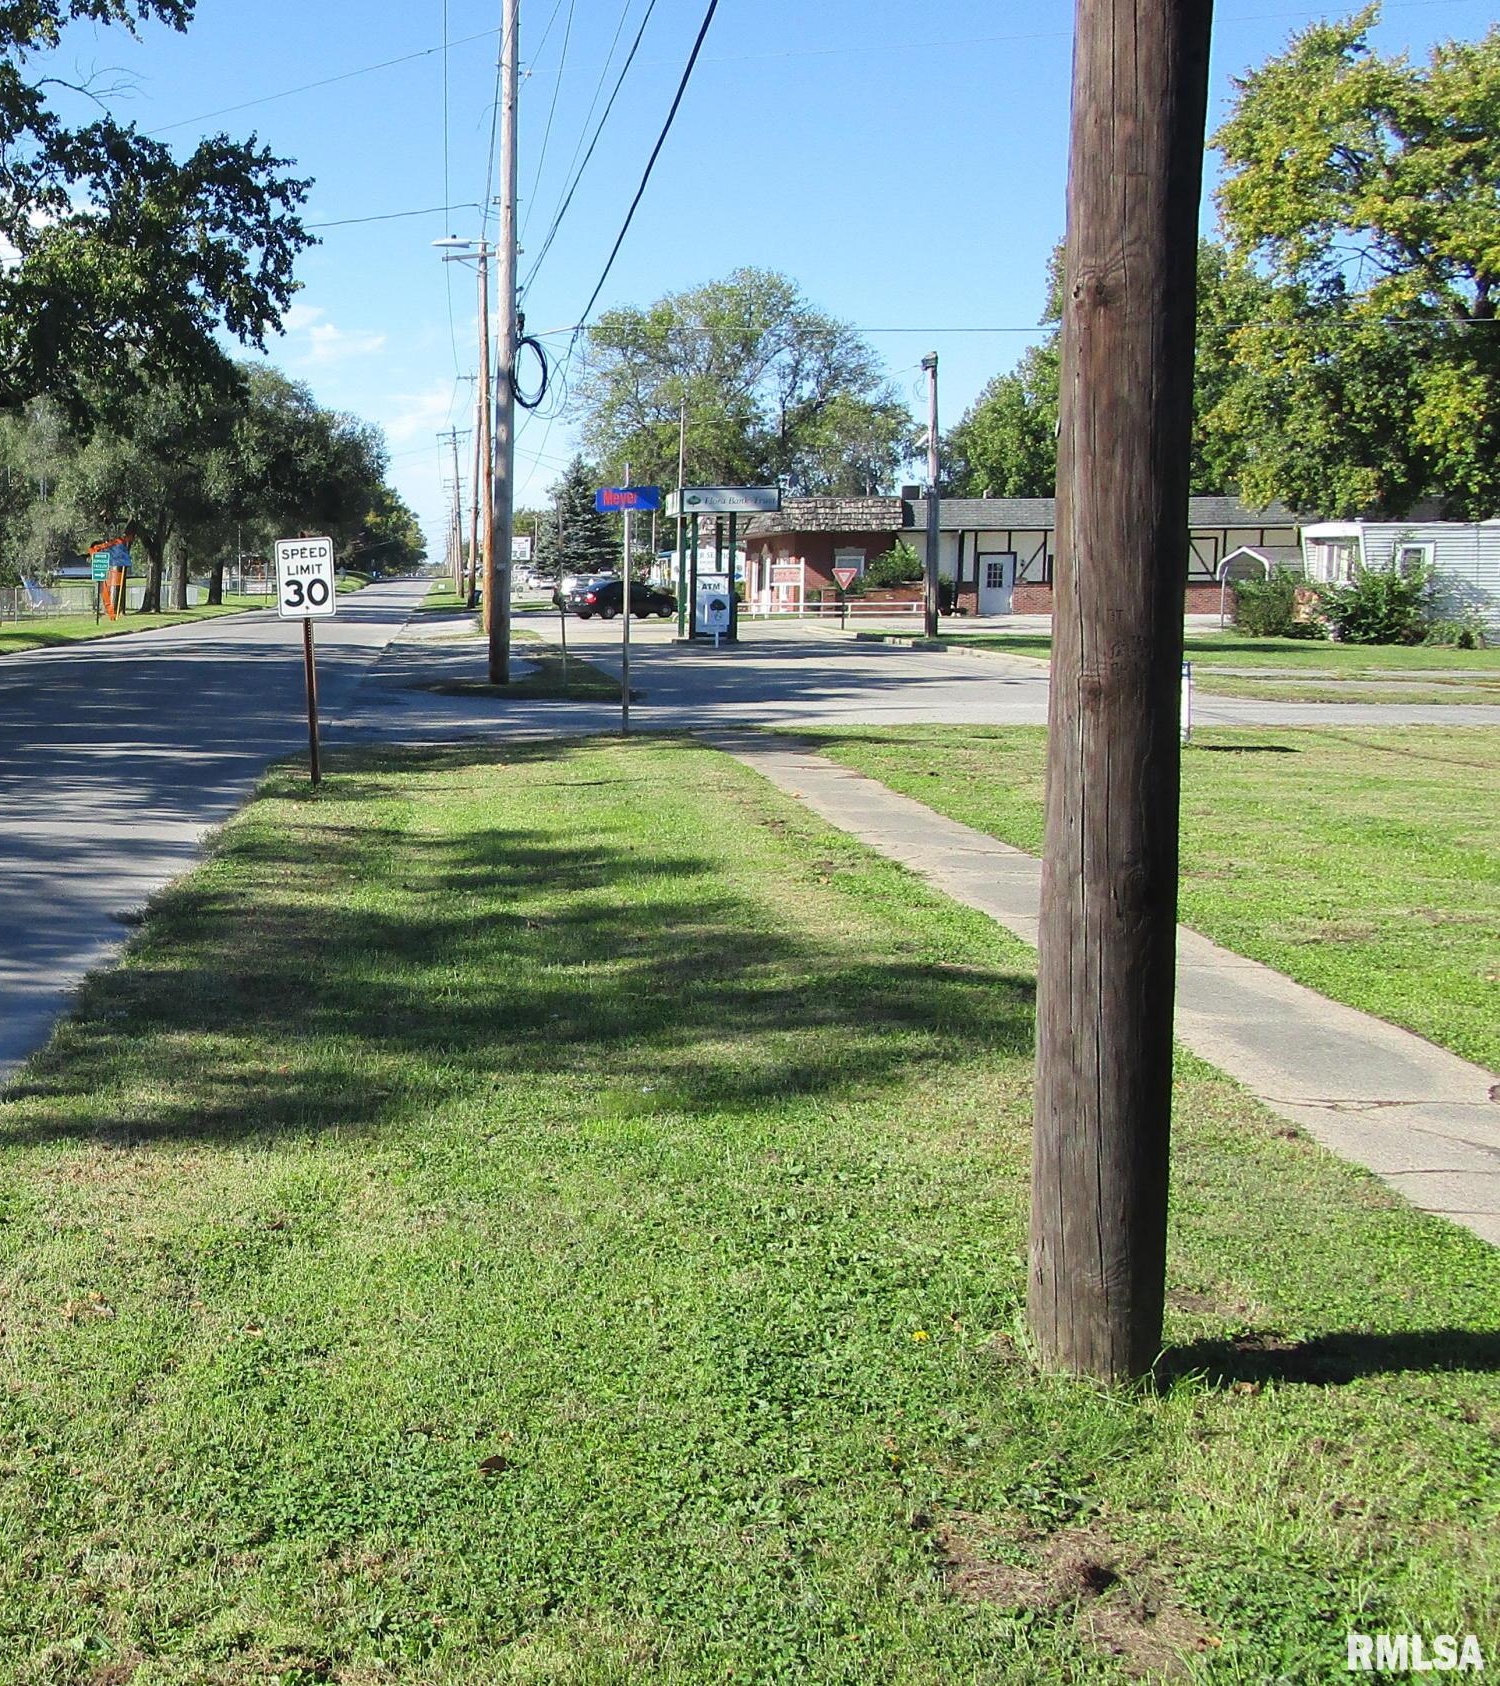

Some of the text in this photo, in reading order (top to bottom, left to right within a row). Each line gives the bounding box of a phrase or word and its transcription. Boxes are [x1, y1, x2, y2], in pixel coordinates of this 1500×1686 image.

[282, 547, 327, 559] SPEED
[287, 563, 322, 576] LIMIT
[284, 578, 329, 607] 30
